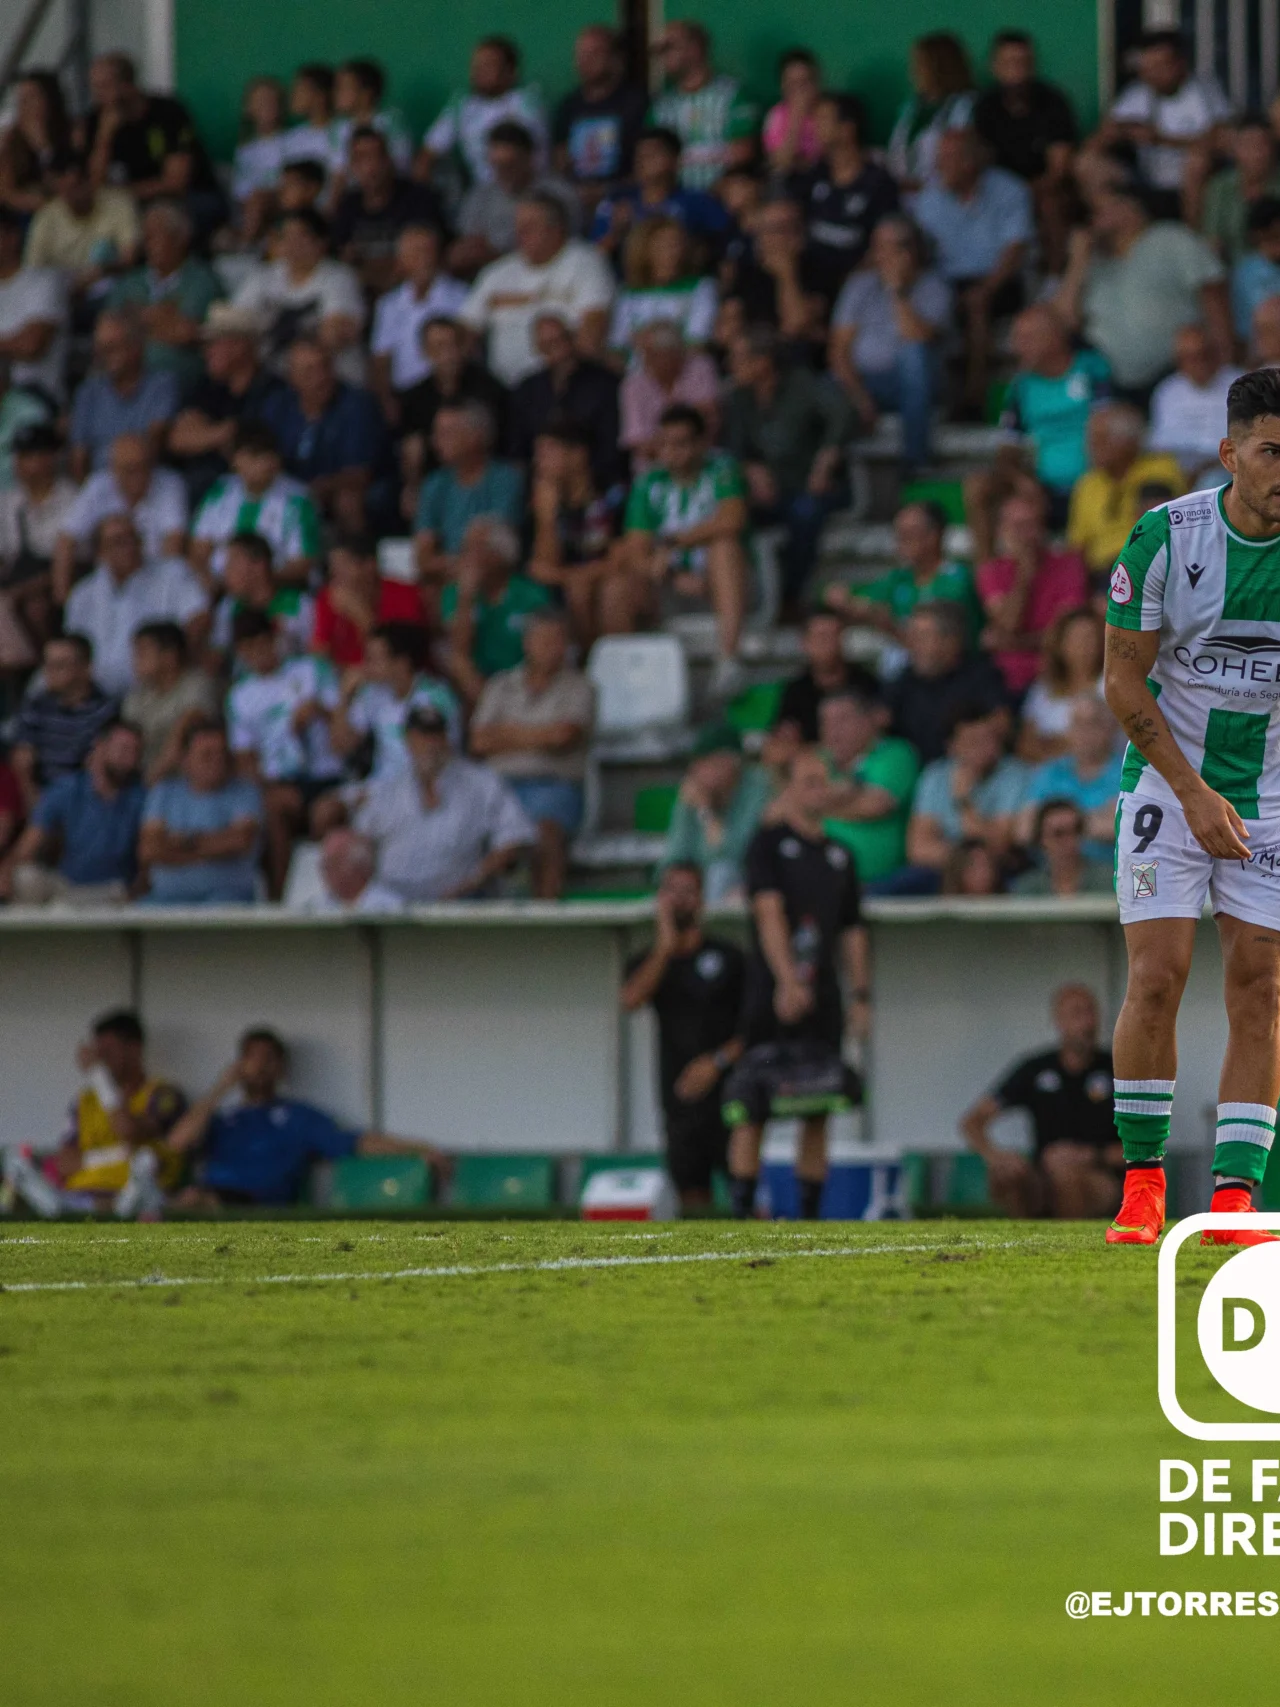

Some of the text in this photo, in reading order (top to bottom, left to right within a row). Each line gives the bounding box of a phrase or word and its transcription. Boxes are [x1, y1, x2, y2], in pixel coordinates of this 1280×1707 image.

[1183, 508, 1212, 518] Innova
[1243, 689, 1257, 699] de
[1131, 804, 1163, 853] 9
